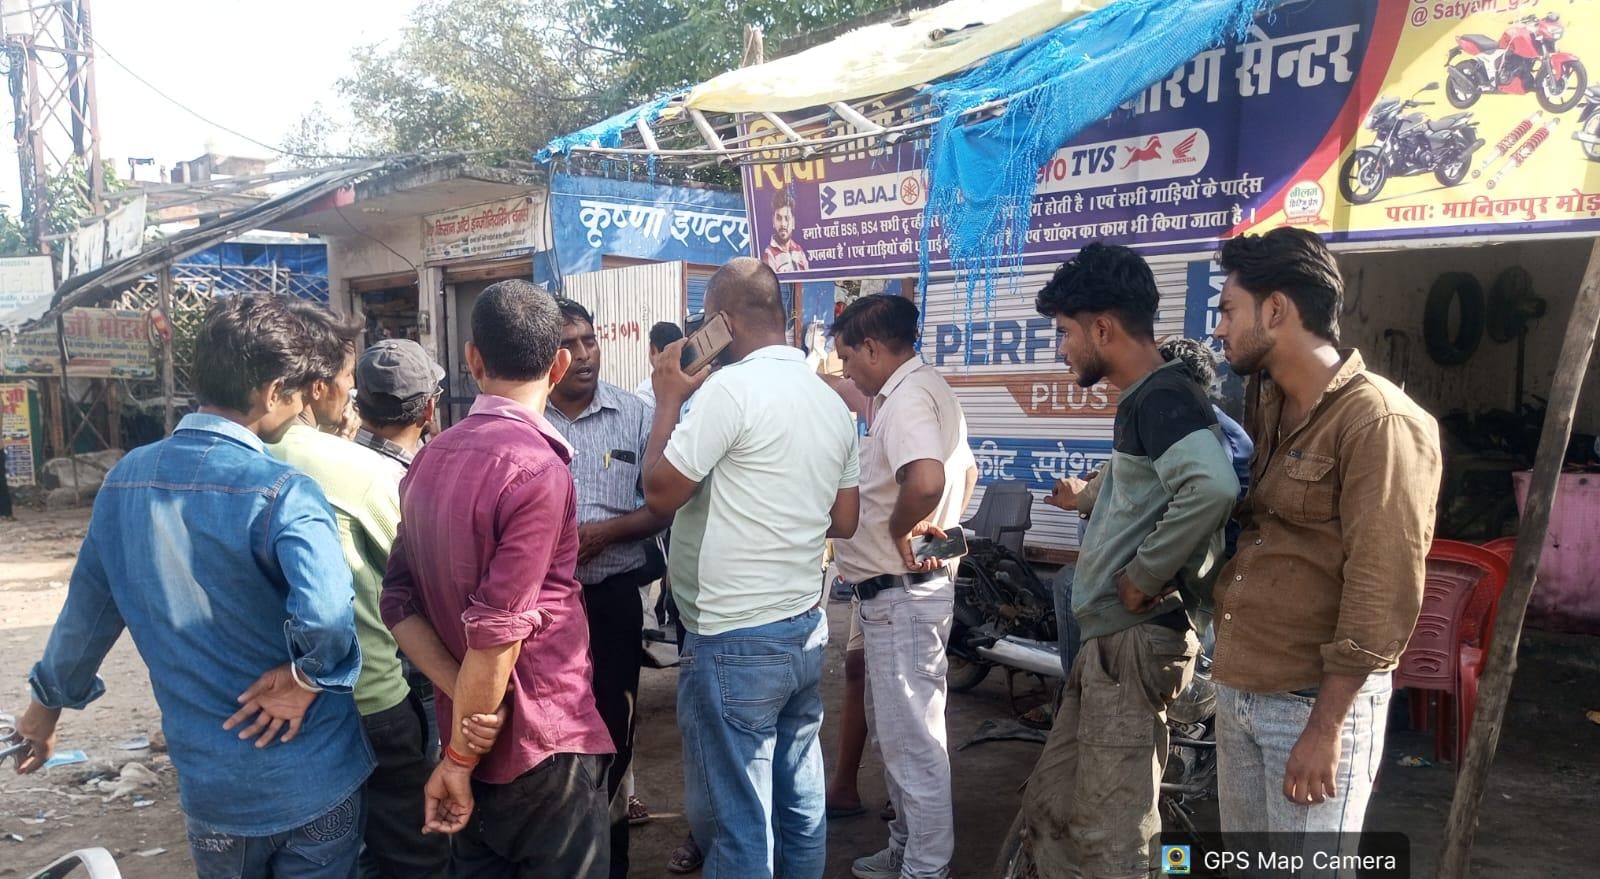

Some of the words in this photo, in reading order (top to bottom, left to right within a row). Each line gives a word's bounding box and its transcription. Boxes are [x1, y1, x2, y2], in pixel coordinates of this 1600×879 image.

[1036, 158, 1067, 184] ero
[1071, 145, 1117, 177] TVS
[1171, 156, 1197, 165] HONDA
[843, 183, 898, 207] BAJAJ
[1043, 195, 1073, 216] होती
[1118, 186, 1149, 207] सभी
[1150, 178, 1201, 206] गाड़ियों
[1201, 178, 1219, 198] के
[1220, 173, 1265, 199] पार्ट्स
[1442, 195, 1552, 221] मानिकपुर
[579, 200, 666, 248] कृष्णा
[671, 210, 751, 252] इण्टरप्र
[802, 223, 822, 240] हमारे
[861, 220, 878, 235] BS4
[879, 215, 900, 232] सभी
[1079, 223, 1098, 239] का
[1099, 220, 1129, 237] काम
[1131, 214, 1149, 233] भी
[1151, 212, 1188, 232] किया
[1189, 210, 1229, 228] जाता
[1231, 203, 1243, 225] है
[899, 237, 912, 254] की
[1031, 380, 1109, 411] PLUS
